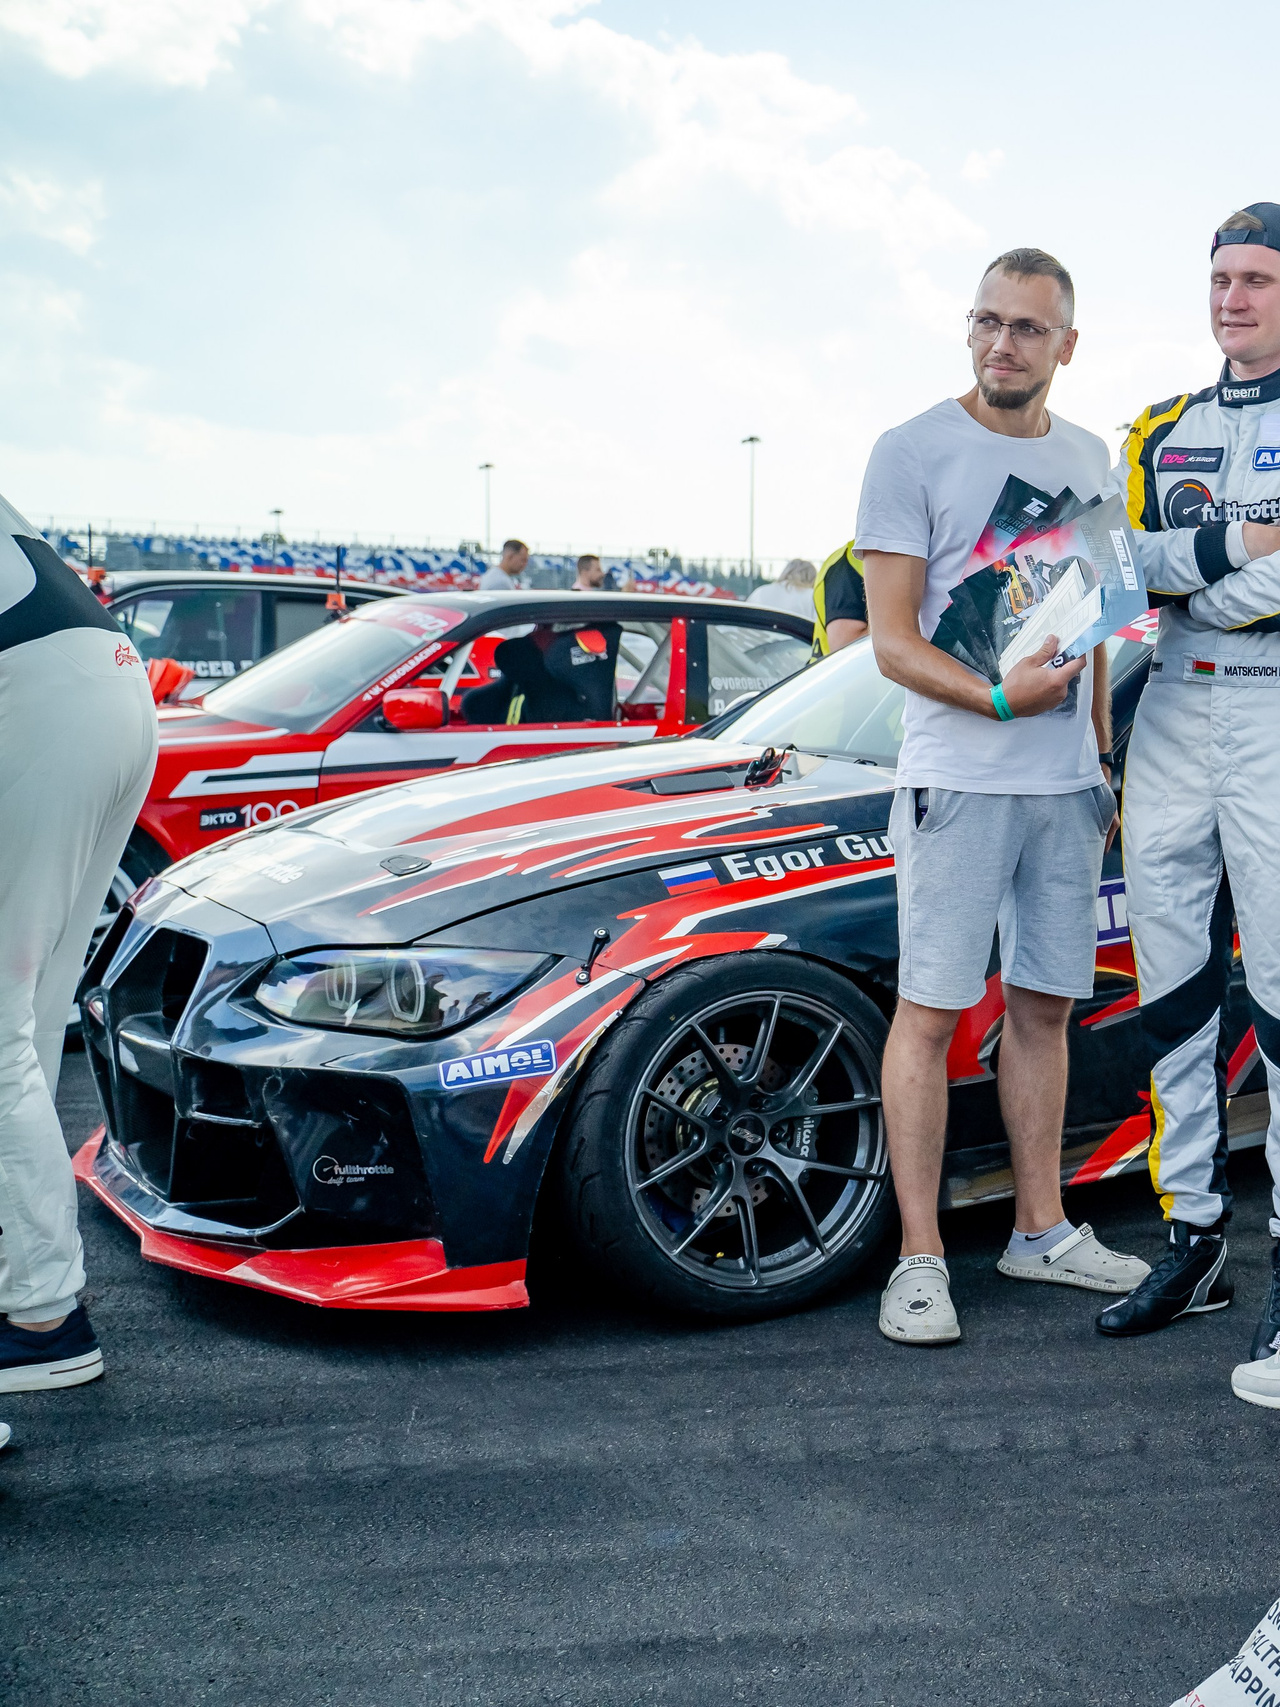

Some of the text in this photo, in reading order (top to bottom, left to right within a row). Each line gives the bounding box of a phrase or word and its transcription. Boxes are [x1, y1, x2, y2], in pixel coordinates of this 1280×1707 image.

[1221, 385, 1261, 400] freem
[1161, 454, 1189, 464] RDS
[1224, 665, 1278, 677] MATSKEVICH
[720, 846, 824, 882] Egor
[446, 1048, 551, 1082] AIMOL
[333, 1164, 395, 1176] fullthrottle
